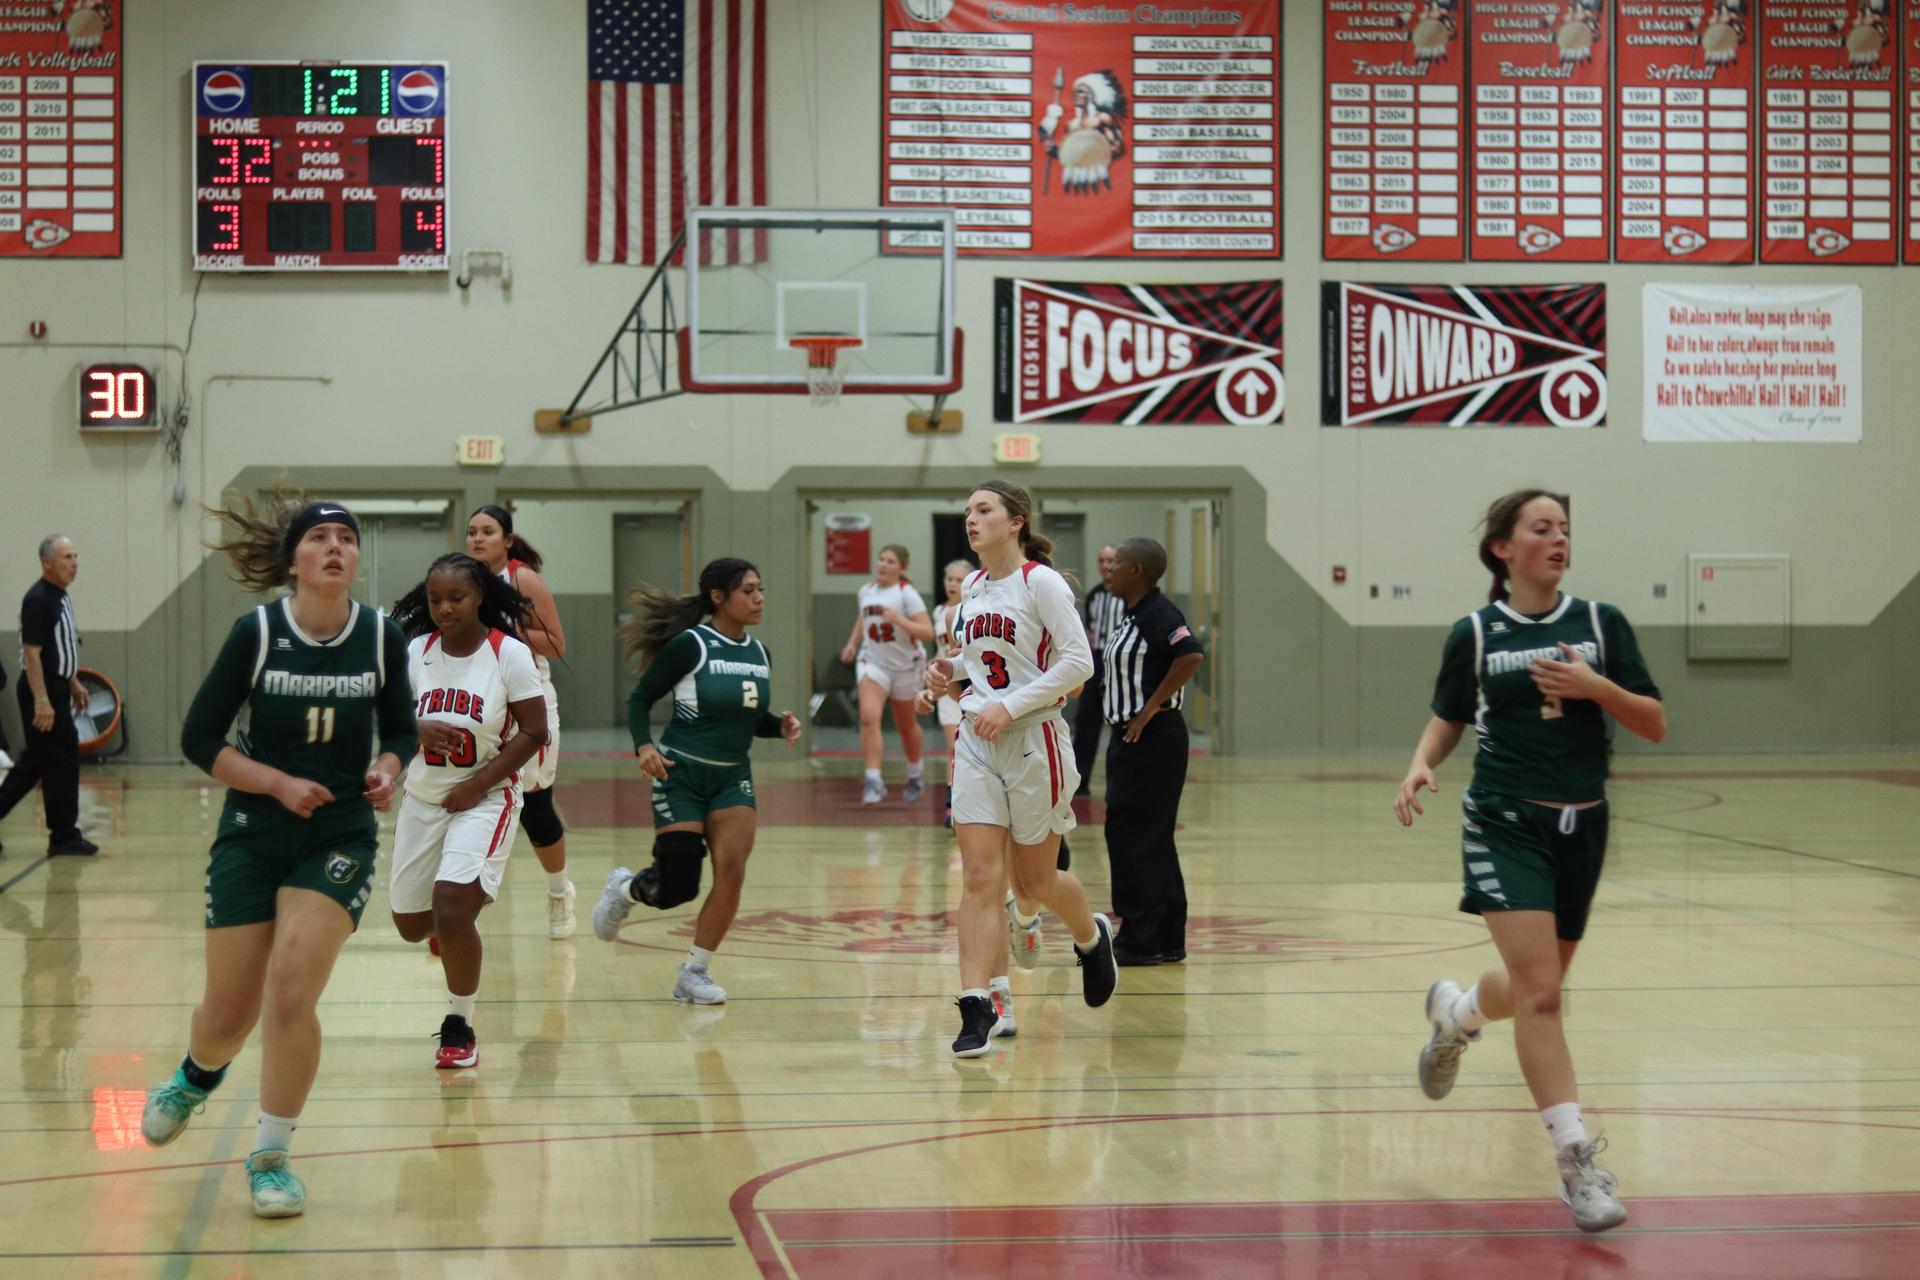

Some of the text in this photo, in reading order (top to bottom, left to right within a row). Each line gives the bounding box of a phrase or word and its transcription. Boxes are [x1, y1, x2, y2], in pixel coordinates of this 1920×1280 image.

[989, 4, 1242, 28] Central Section Champions
[1347, 16, 1395, 27] LEAGUE
[1493, 18, 1540, 28] LEAGUE
[1639, 20, 1685, 31] LEAGUE
[1783, 22, 1829, 33] LEAGUE
[940, 36, 1010, 48] FOOTBALL
[1181, 39, 1264, 49] VOLLEYBALL
[27, 51, 115, 72] Volleyball
[940, 57, 1009, 70] FOOTBALL
[1188, 62, 1254, 72] FOOTBALL
[1351, 58, 1429, 76] Football
[33, 79, 60, 91] 2009
[940, 80, 1009, 93] FOOTBALL
[1172, 83, 1211, 93] GIRLS
[1215, 83, 1266, 93] SOCCER
[304, 69, 389, 115] 1:21
[33, 102, 62, 114] 2010
[1181, 105, 1219, 116] GIRLS
[1223, 105, 1257, 116] GOLF
[34, 125, 61, 136] 2011
[209, 118, 260, 134] HOME
[296, 121, 344, 134] PERIOD
[376, 118, 436, 134] GUEST
[940, 124, 1009, 136] BASEBALL
[1188, 127, 1261, 137] BASEBALL
[302, 152, 340, 165] POSS
[929, 146, 965, 157] BOYS
[969, 147, 1023, 158] SOCCER
[1187, 150, 1250, 160] FOOTBALL
[213, 139, 271, 184] 32
[416, 139, 442, 183] 7
[298, 167, 344, 181] BONUS
[940, 168, 1008, 180] SOFTBALL
[1183, 171, 1246, 181] SOFTBALL
[198, 187, 242, 200] FOULS
[273, 187, 325, 200] PLAYER
[342, 187, 378, 200] FOUL
[401, 187, 445, 200] FOULS
[1213, 193, 1253, 203] TENNIS
[1179, 214, 1269, 224] FOOTBALL
[213, 205, 240, 251] 3
[416, 205, 443, 250] 4
[275, 255, 320, 267] MATCH
[1745, 307, 1765, 330] long
[1767, 312, 1787, 330] may
[1807, 307, 1831, 330] reign
[1023, 300, 1040, 400] REDSKINS
[1046, 300, 1193, 400] FOCUS
[1666, 335, 1684, 352] Hail
[1687, 336, 1697, 352] to
[1699, 335, 1713, 352] her
[1782, 336, 1800, 353] true
[1803, 336, 1835, 353] remain
[1350, 303, 1366, 403] REDSKINS
[1370, 303, 1516, 404] ONWARD
[1664, 358, 1676, 376] So
[1678, 363, 1690, 376] we
[1763, 359, 1778, 376] her
[1781, 359, 1814, 381] praises
[1817, 359, 1836, 381] long
[89, 372, 144, 418] 30
[1657, 384, 1678, 406] Hail
[1682, 385, 1692, 406] to
[466, 438, 496, 460] EXIT
[964, 612, 1017, 646] TRIBE
[981, 650, 1011, 690] 3
[264, 670, 376, 698] MARIPOSA
[742, 680, 759, 709] 2
[418, 688, 485, 724] TRIBE
[306, 706, 336, 745] 11
